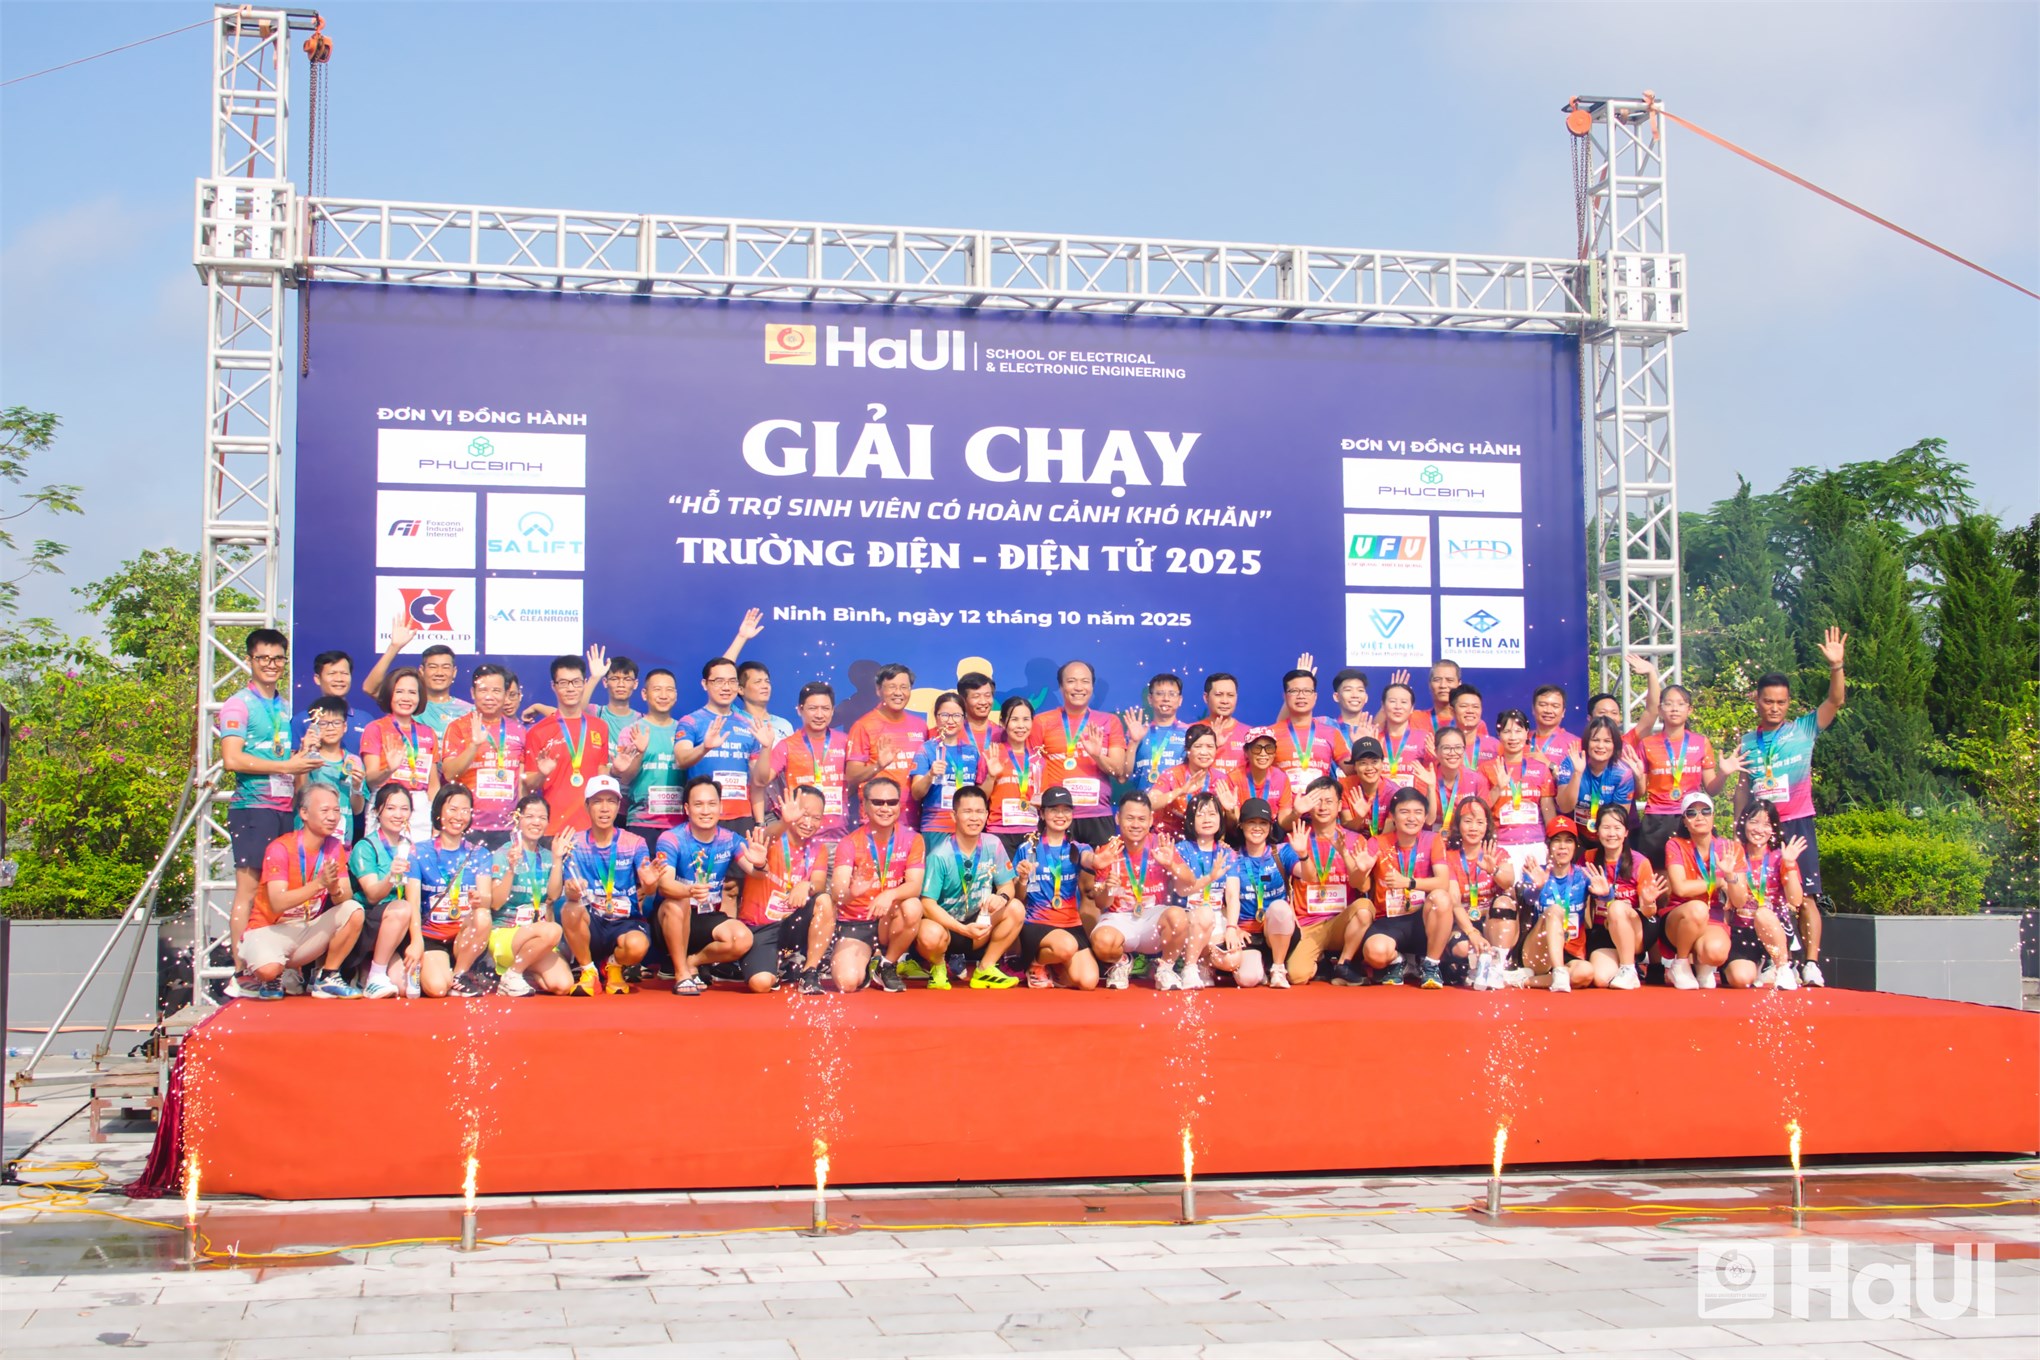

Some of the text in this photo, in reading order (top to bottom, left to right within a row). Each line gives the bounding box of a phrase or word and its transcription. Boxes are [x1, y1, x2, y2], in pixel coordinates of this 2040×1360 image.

[826, 326, 965, 371] HaUI
[985, 348, 1155, 365] SCHOOL OF ELECTRICAL
[986, 361, 1186, 379] & ELECTRONIC ENGINEERING
[376, 407, 587, 426] ĐƠN VỊ ĐỒNG HÀNH
[742, 403, 1201, 498] GIẢI CHẠY
[1341, 438, 1521, 456] ĐƠN VỊ ĐỒNG HÀNH
[668, 489, 1272, 528] “HỖ TRỢ SINH VIÊN CÓ HOÀN CẢNH KHÓ KHĂN”
[487, 540, 583, 554] SA LIFT
[676, 534, 855, 567] TRƯỜNG
[866, 537, 960, 574] ĐIỆN
[998, 540, 1090, 576] ĐIỆN
[1101, 539, 1158, 572] TỬ
[1165, 547, 1262, 575] 2025
[1448, 539, 1512, 560] NTD
[773, 606, 1192, 627] Ninh Bình, ngày 12 tháng 10 năm 2025
[451, 633, 472, 641] LTD
[1360, 640, 1414, 651] VIỆT LINH
[1444, 636, 1520, 648] THIÊN AN
